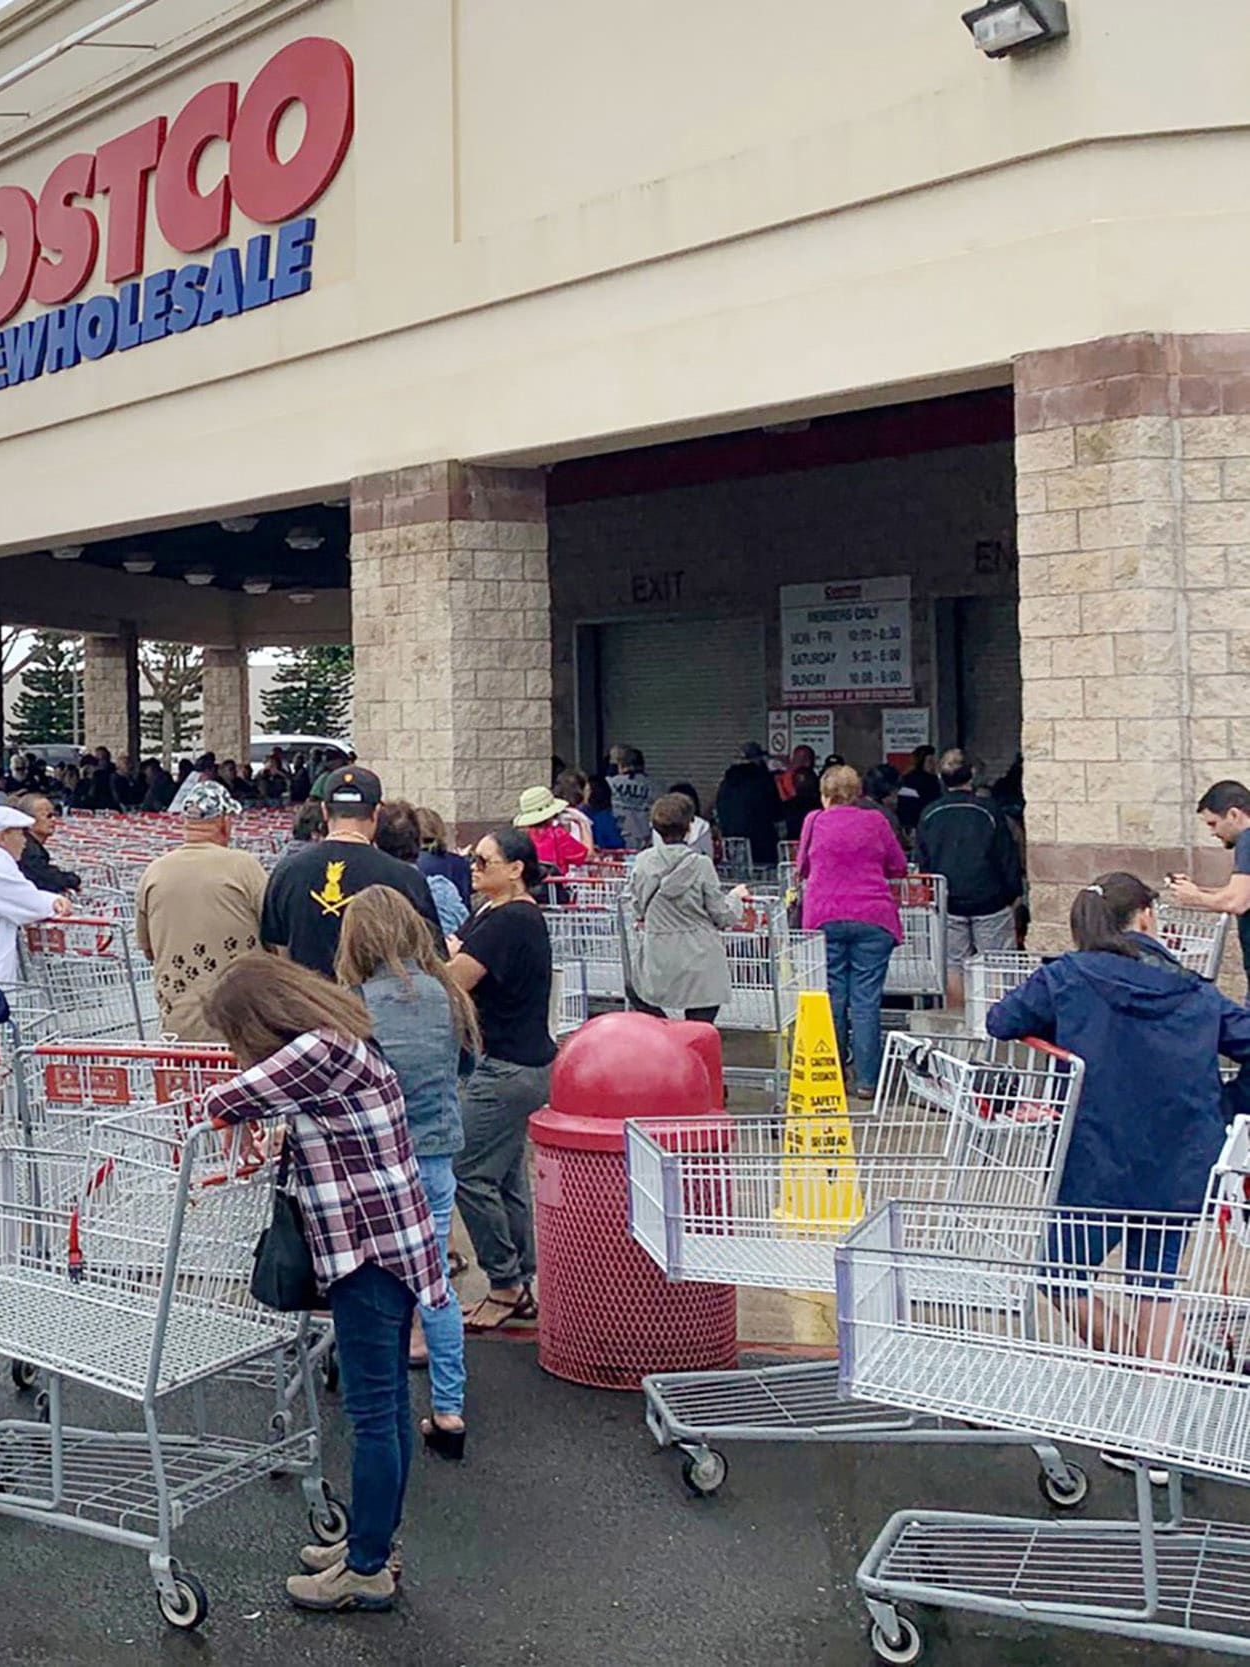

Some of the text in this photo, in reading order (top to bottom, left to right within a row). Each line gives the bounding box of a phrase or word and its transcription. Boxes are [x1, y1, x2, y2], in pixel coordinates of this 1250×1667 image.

[2, 217, 316, 386] WHOLESALE
[632, 570, 685, 600] EXIT
[854, 607, 879, 620] ONLY
[817, 630, 832, 643] FRI
[791, 652, 837, 665] SATURDAY
[791, 673, 826, 686] SUNDAY
[811, 1057, 836, 1067] CAUTION
[810, 1095, 841, 1107] SAFETY
